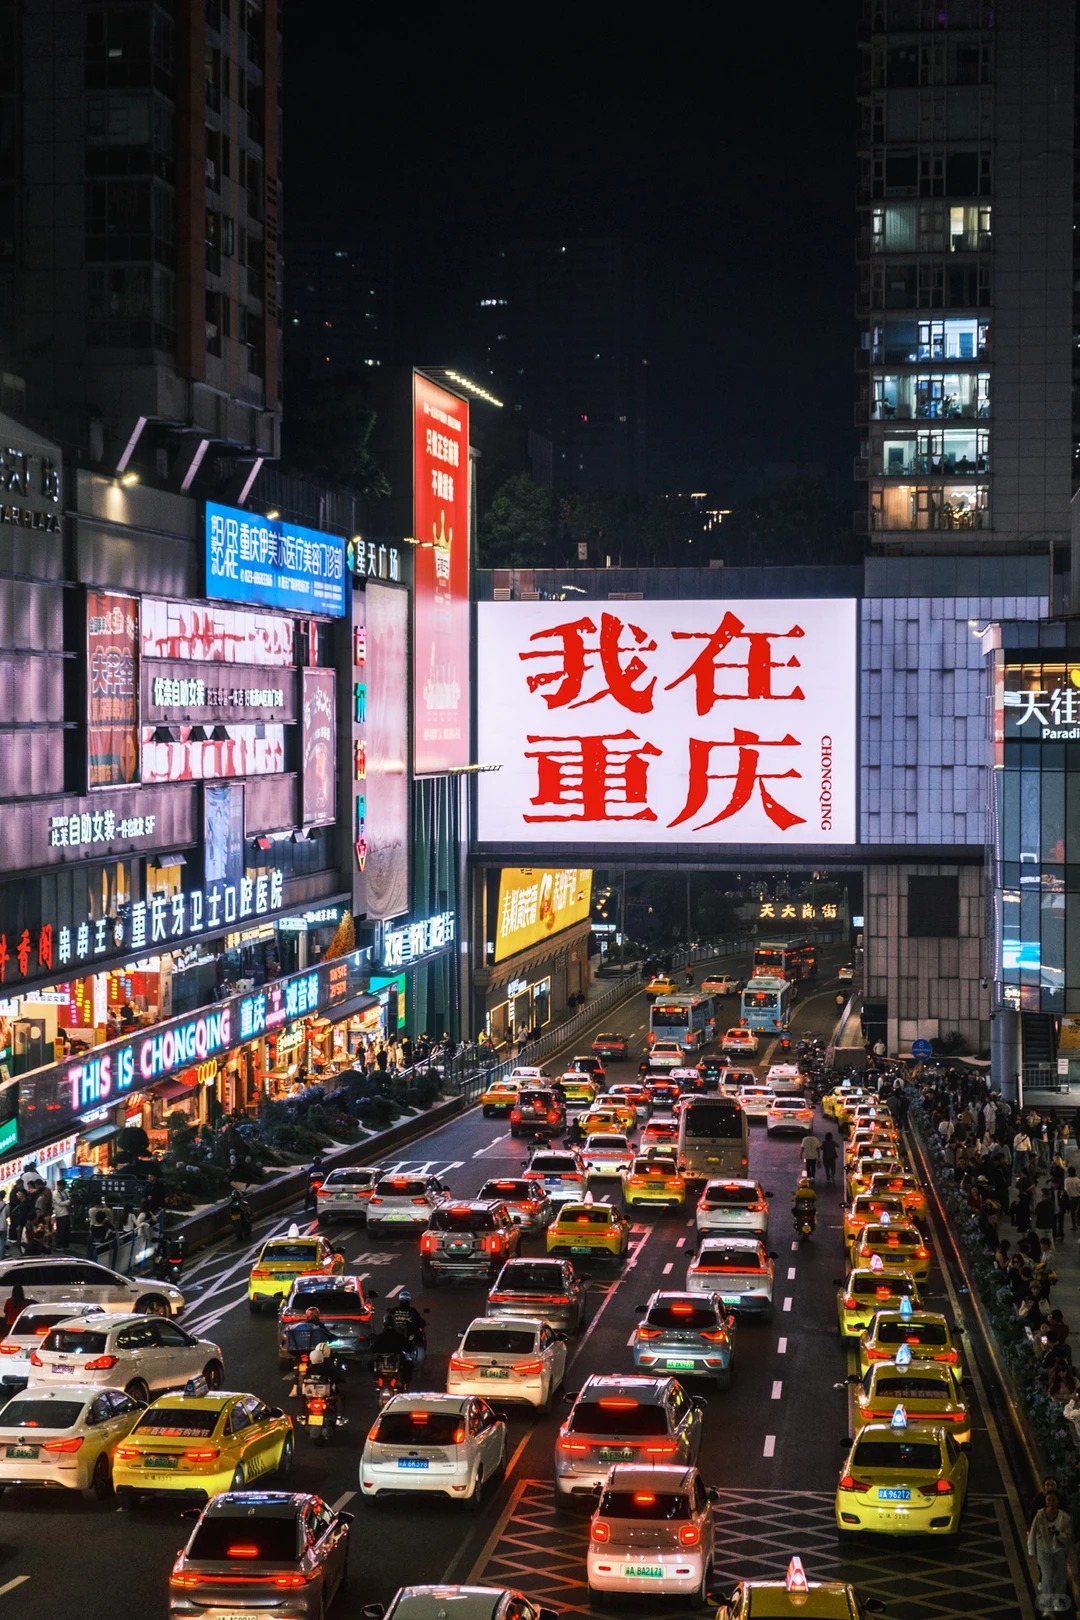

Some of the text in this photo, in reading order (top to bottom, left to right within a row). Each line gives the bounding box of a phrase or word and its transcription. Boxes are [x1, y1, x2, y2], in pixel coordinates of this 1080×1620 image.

[356, 540, 398, 581] 星天广场
[519, 611, 806, 716] 我在
[522, 728, 808, 831] 重庆
[820, 735, 833, 831] CHONGQING
[69, 809, 115, 845] 自助女装
[131, 868, 284, 949] 重庆牙卫士口腔医院
[59, 919, 107, 965] 串串王
[240, 994, 266, 1039] 重庆
[286, 973, 318, 1017] 观音桥
[68, 1056, 111, 1109] THIS
[118, 1046, 134, 1089] IS
[140, 1009, 231, 1078] CHONGQING
